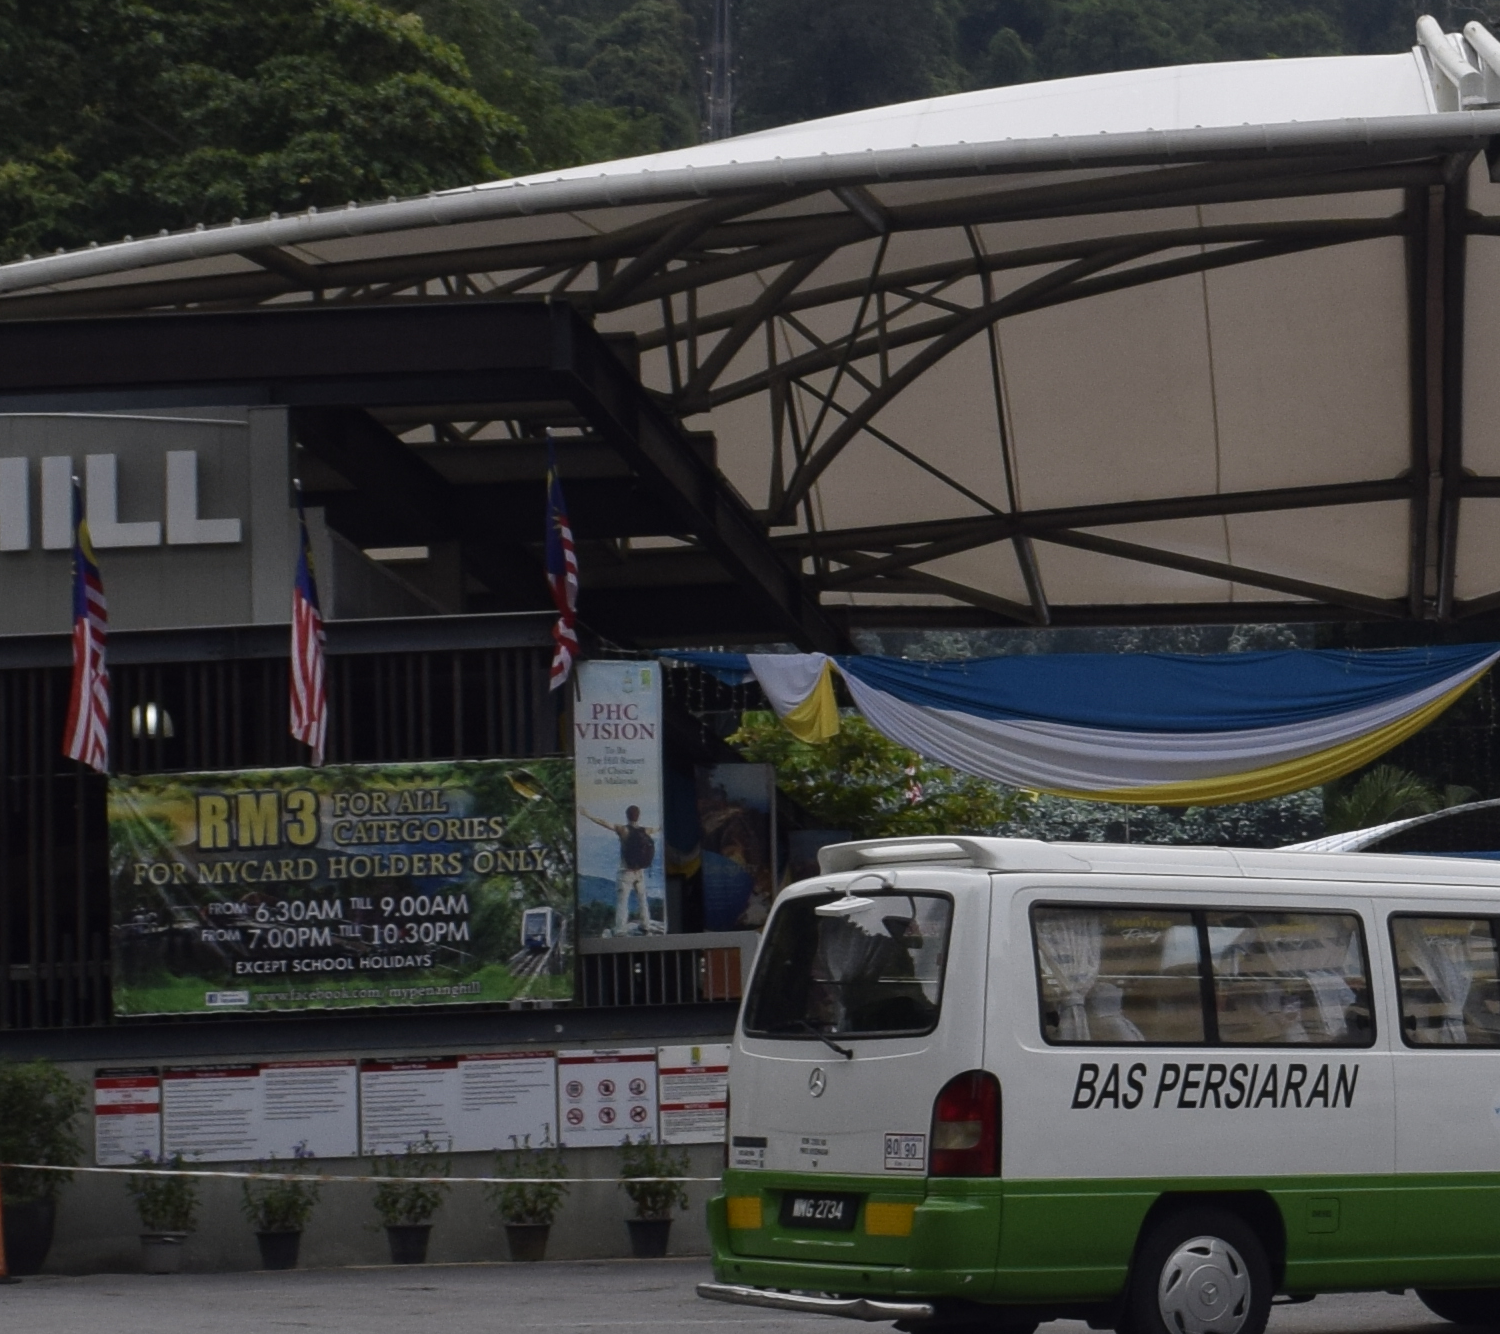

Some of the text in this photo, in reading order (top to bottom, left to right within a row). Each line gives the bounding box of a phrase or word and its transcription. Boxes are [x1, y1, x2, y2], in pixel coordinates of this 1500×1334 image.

[591, 703, 639, 721] PHC
[575, 723, 656, 740] VISION
[332, 788, 448, 817] FOR ALL
[197, 788, 319, 851] RM3
[332, 815, 505, 845] CATEGORIES
[133, 847, 549, 885] FOR MYCARD HOLDERS ONLY
[208, 894, 469, 923] FROM 6.30AM TILL 9.00AM
[201, 921, 471, 951] FROM 7.00PM TILL 10.30PM
[236, 953, 433, 974] EXCEPT SCHOOL HOLIDAYS
[1071, 1062, 1360, 1111] BAS PERSIARAN
[886, 1138, 917, 1158] 80 90
[814, 1199, 845, 1220] 2734
